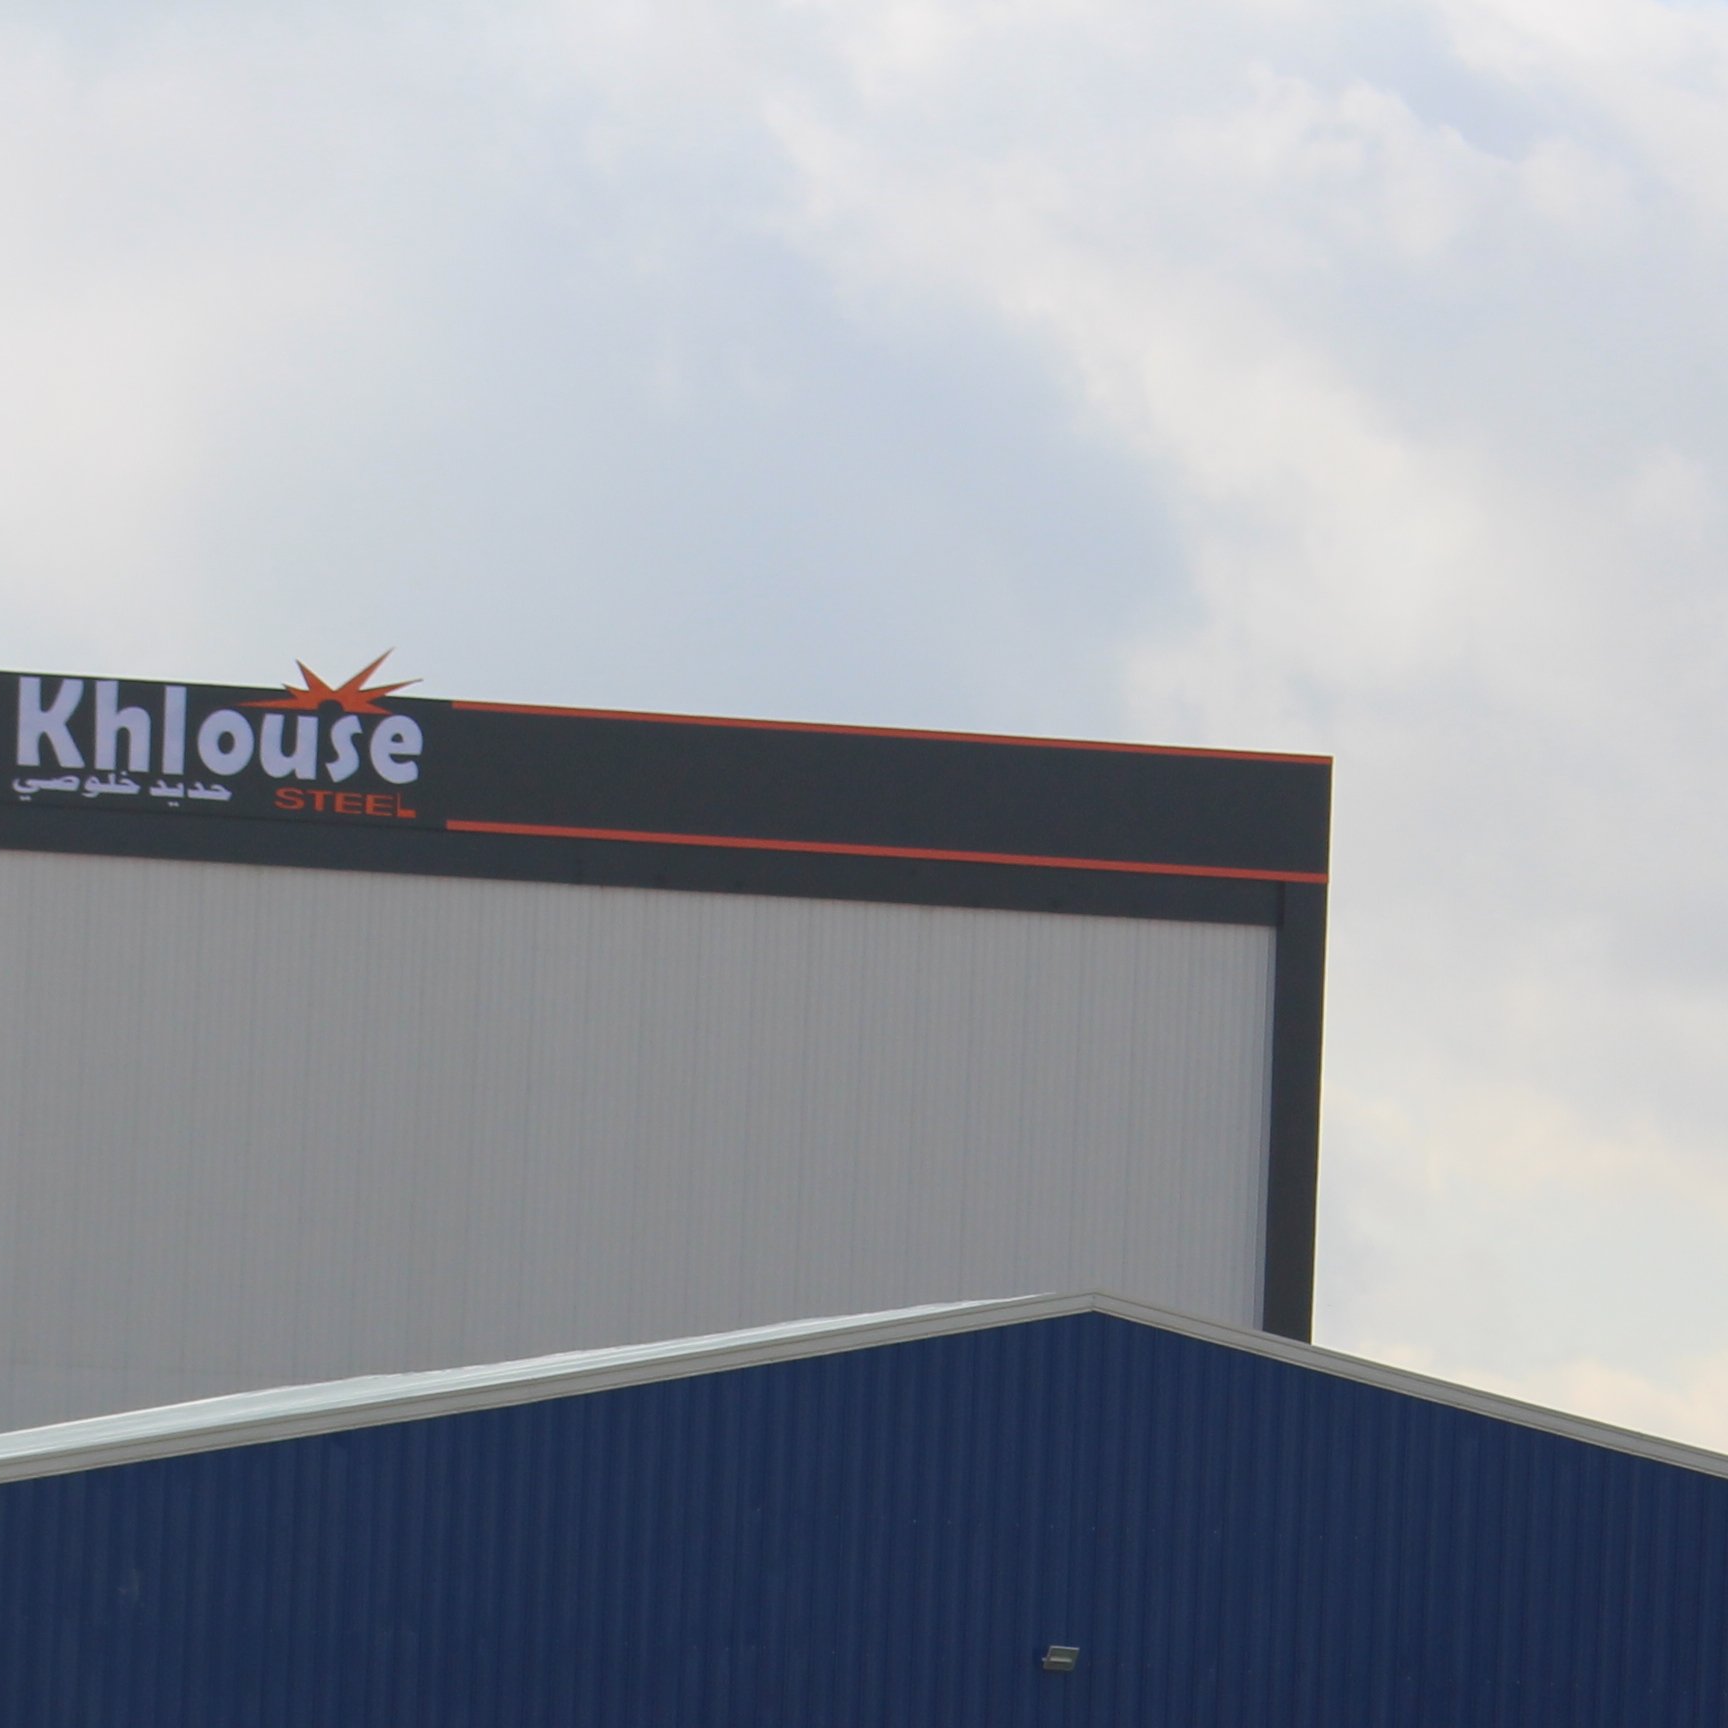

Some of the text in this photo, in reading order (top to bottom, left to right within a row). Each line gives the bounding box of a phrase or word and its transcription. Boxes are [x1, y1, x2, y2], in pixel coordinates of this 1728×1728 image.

[16, 676, 424, 784] Khlouse
[12, 770, 233, 807] حديد خلوصي
[273, 787, 417, 819] STEEL
